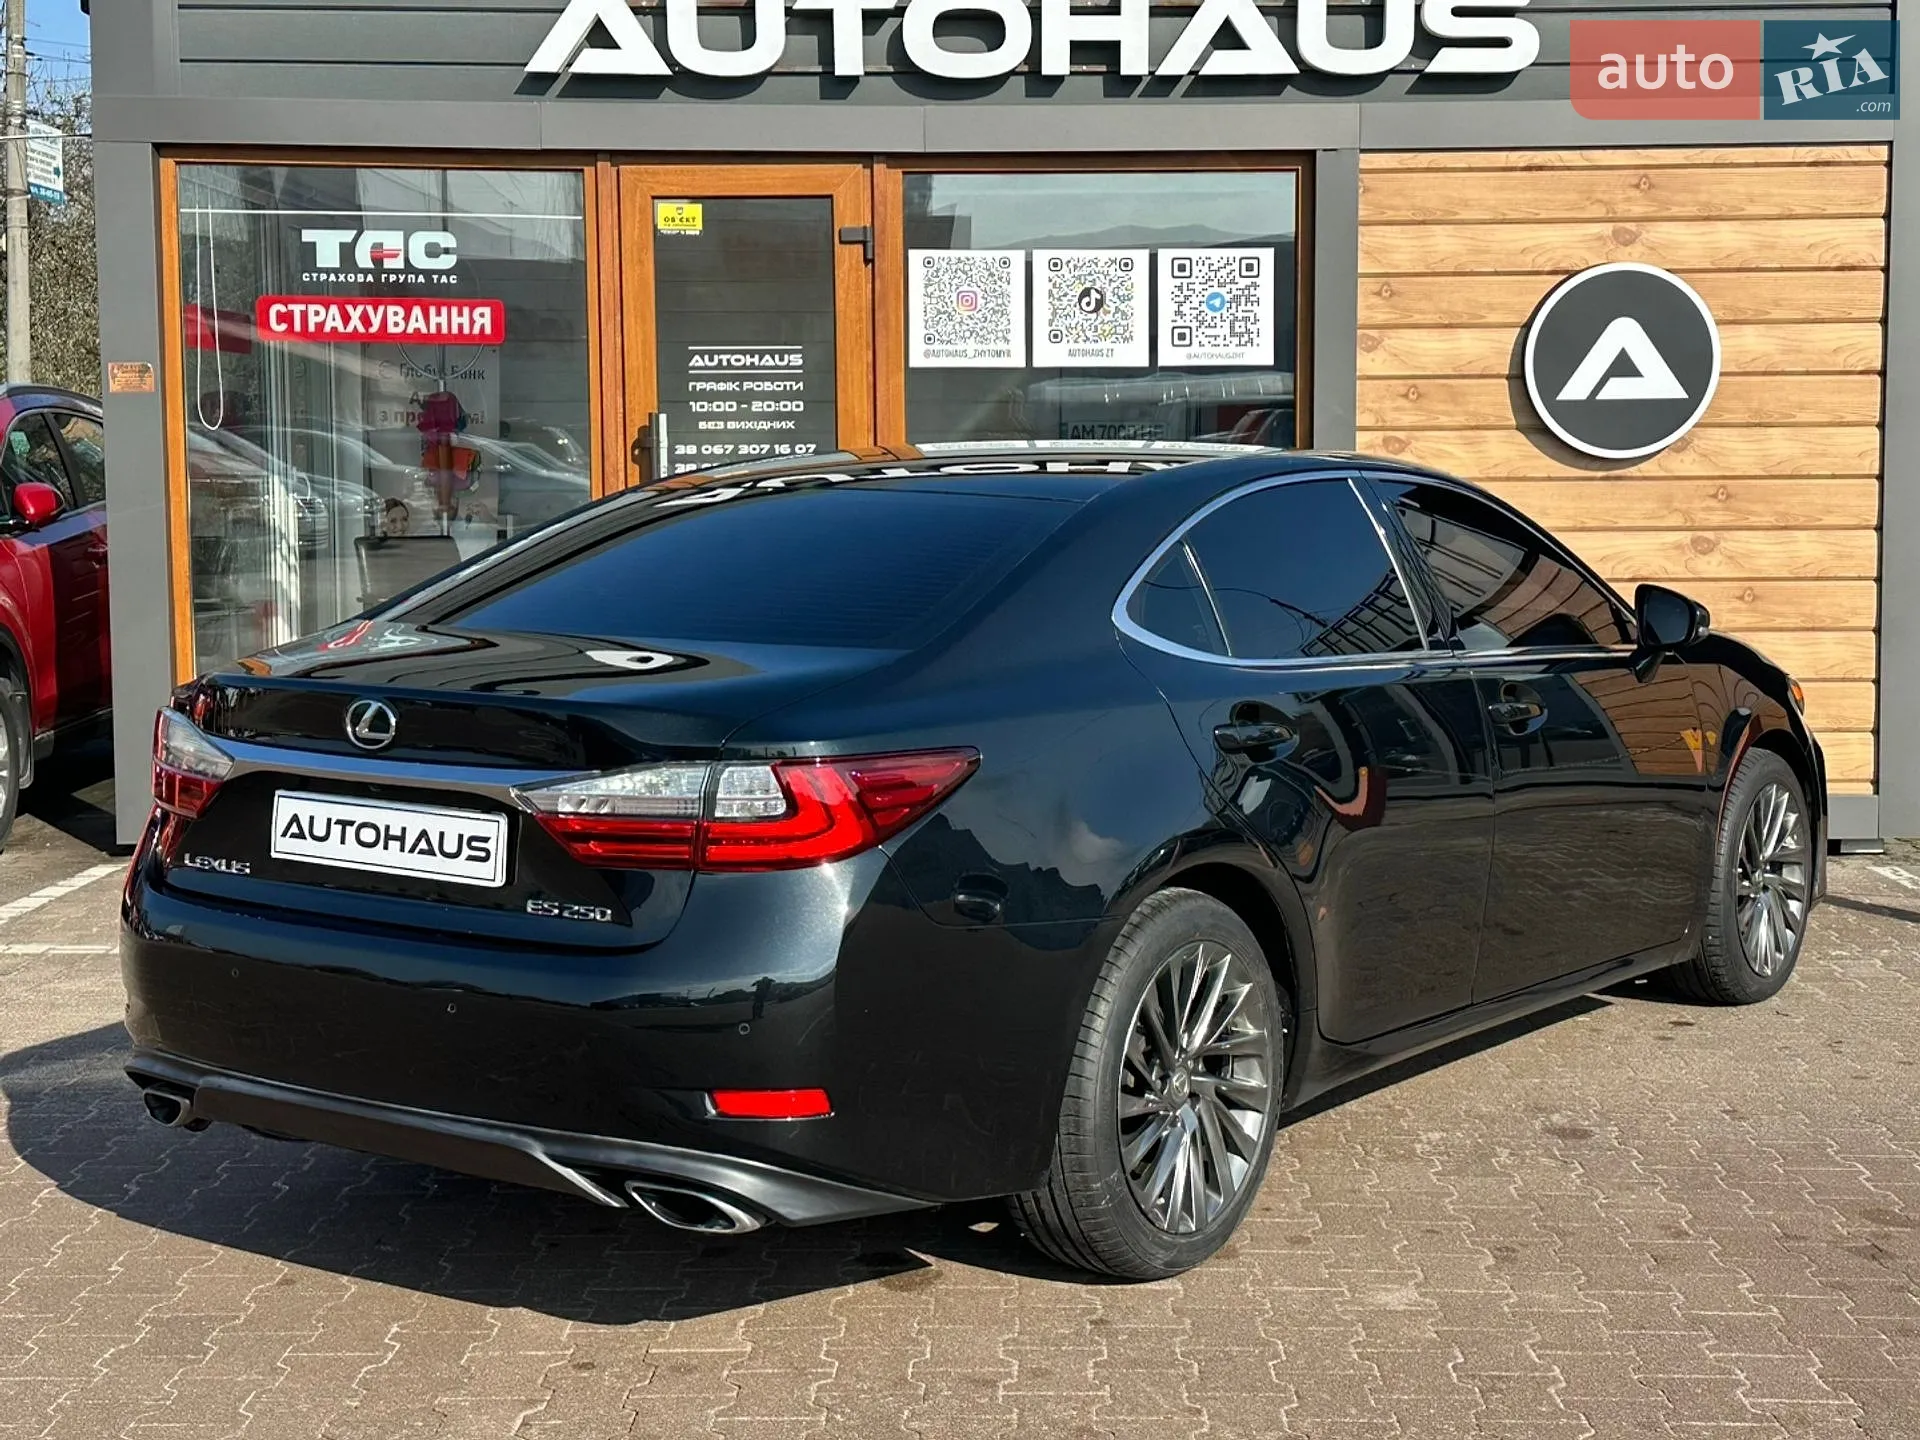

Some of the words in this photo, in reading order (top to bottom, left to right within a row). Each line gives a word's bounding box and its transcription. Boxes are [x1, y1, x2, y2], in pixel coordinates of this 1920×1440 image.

[523, 0, 1540, 78] AUTOHAUS
[302, 272, 375, 283] СТРАХОВА
[381, 273, 426, 284] ГРУПА
[432, 274, 458, 284] ТАС
[268, 303, 492, 335] СТРАХУВАННЯ
[688, 354, 804, 367] AUTOHAUS
[1555, 316, 1690, 400] A
[688, 382, 740, 391] ГРАФІК
[743, 381, 804, 391] РОБОТИ
[689, 401, 737, 412] 10:00
[751, 401, 804, 412] 20:00
[726, 420, 796, 431] ВИХІДНИХ
[674, 445, 697, 455] 38
[701, 445, 735, 455] 067
[738, 445, 771, 455] 307
[773, 444, 791, 454] 16
[794, 444, 817, 455] 07
[280, 813, 492, 863] AUTOHAUS
[183, 852, 251, 875] LEXUS
[526, 899, 560, 916] ES
[562, 903, 612, 922] 250
